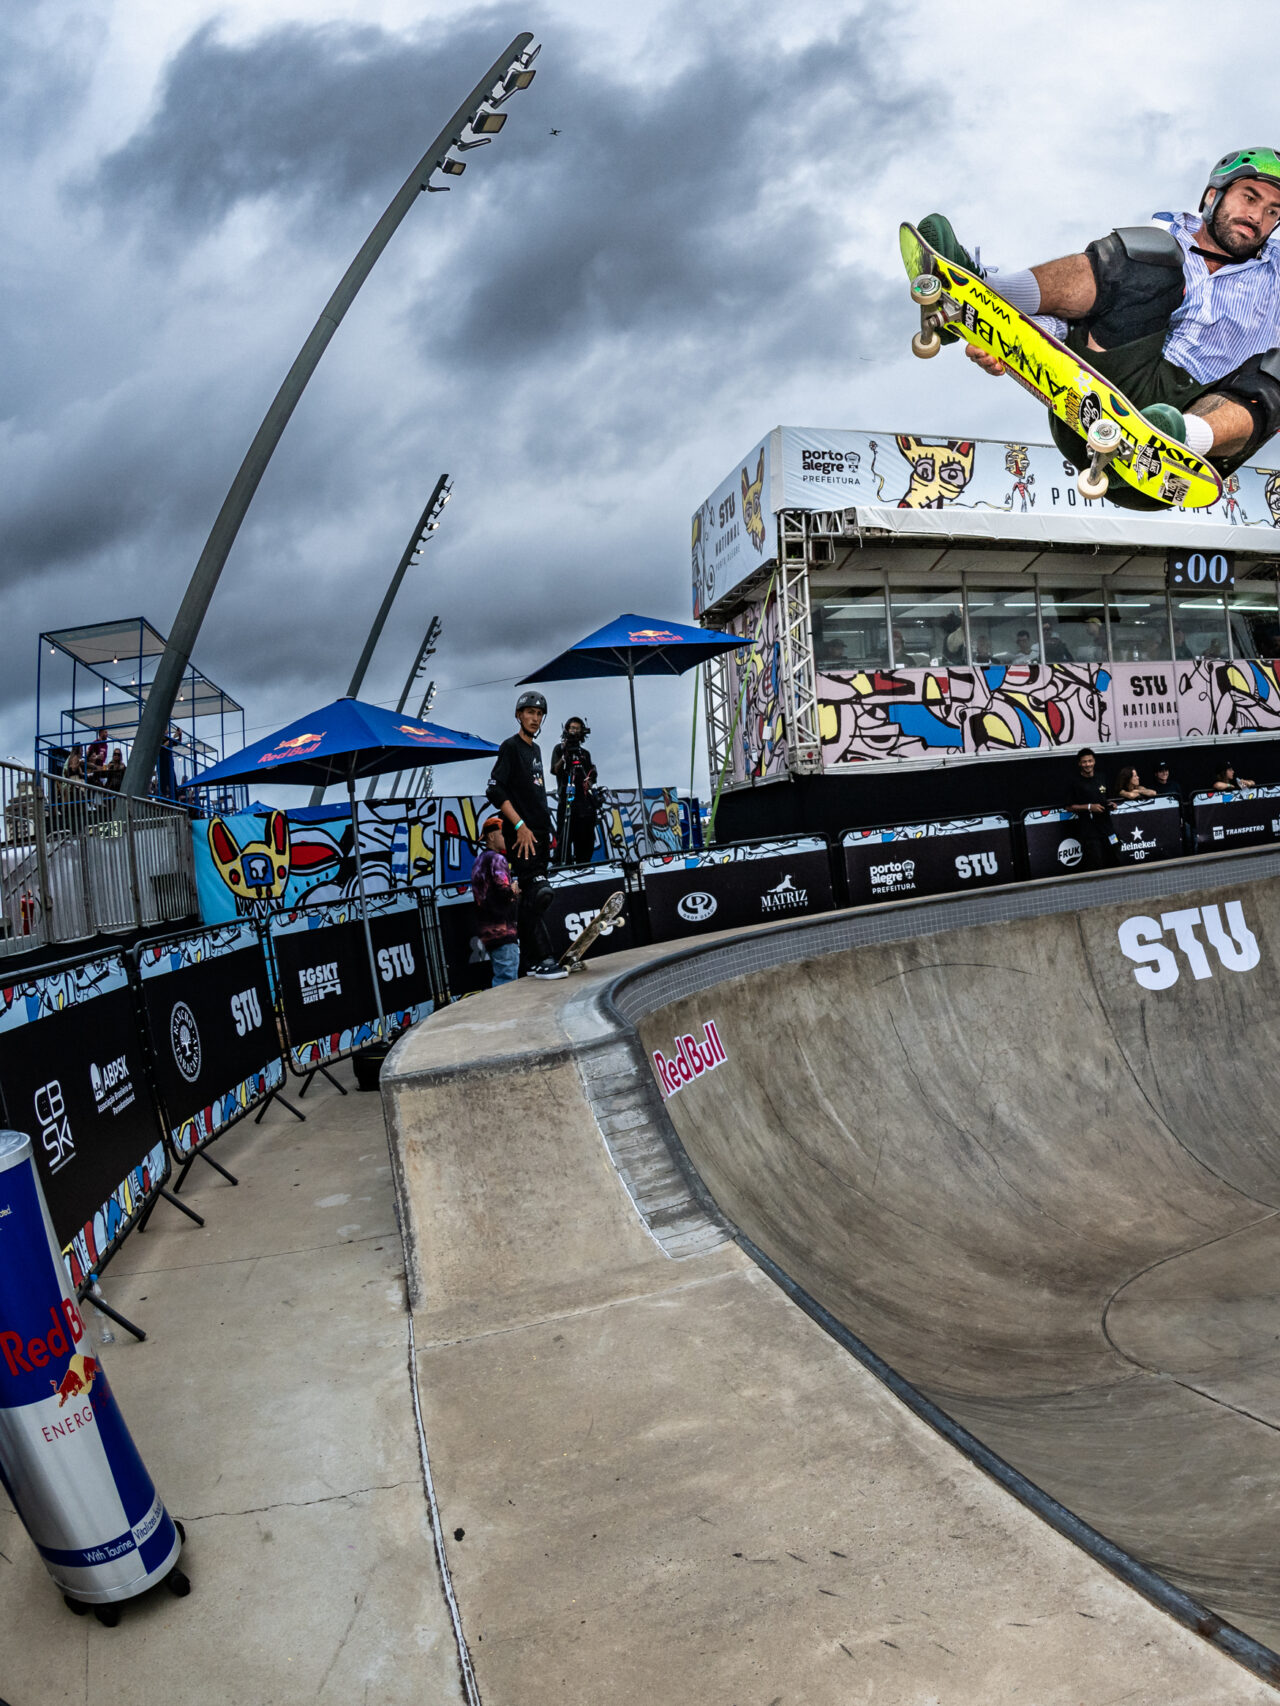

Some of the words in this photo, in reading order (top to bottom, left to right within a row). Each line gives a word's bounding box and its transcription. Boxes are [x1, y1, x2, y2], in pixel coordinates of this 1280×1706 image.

[802, 450, 843, 461] porto
[802, 460, 844, 475] alegre
[802, 475, 861, 485] PREFEITURA
[719, 491, 735, 528] STU
[1130, 675, 1168, 696] STU
[1122, 701, 1179, 717] NATIONAL
[1226, 824, 1265, 836] TRANSPETRO
[1121, 838, 1157, 852] Heineken
[870, 861, 902, 877] porto
[954, 851, 998, 879] STU
[871, 872, 903, 886] alegre
[872, 882, 916, 895] PREFEITURA
[761, 888, 808, 908] MATRIZ
[1118, 900, 1261, 991] STU
[377, 943, 416, 982] STU
[299, 962, 338, 988] FGSKT
[230, 987, 263, 1037] STU
[653, 1036, 695, 1098] Red
[682, 1019, 729, 1078] Bull
[102, 1055, 130, 1091] ABPSK
[0, 1307, 69, 1376] Red
[133, 1516, 157, 1540] Vitalizes
[83, 1549, 107, 1563] With
